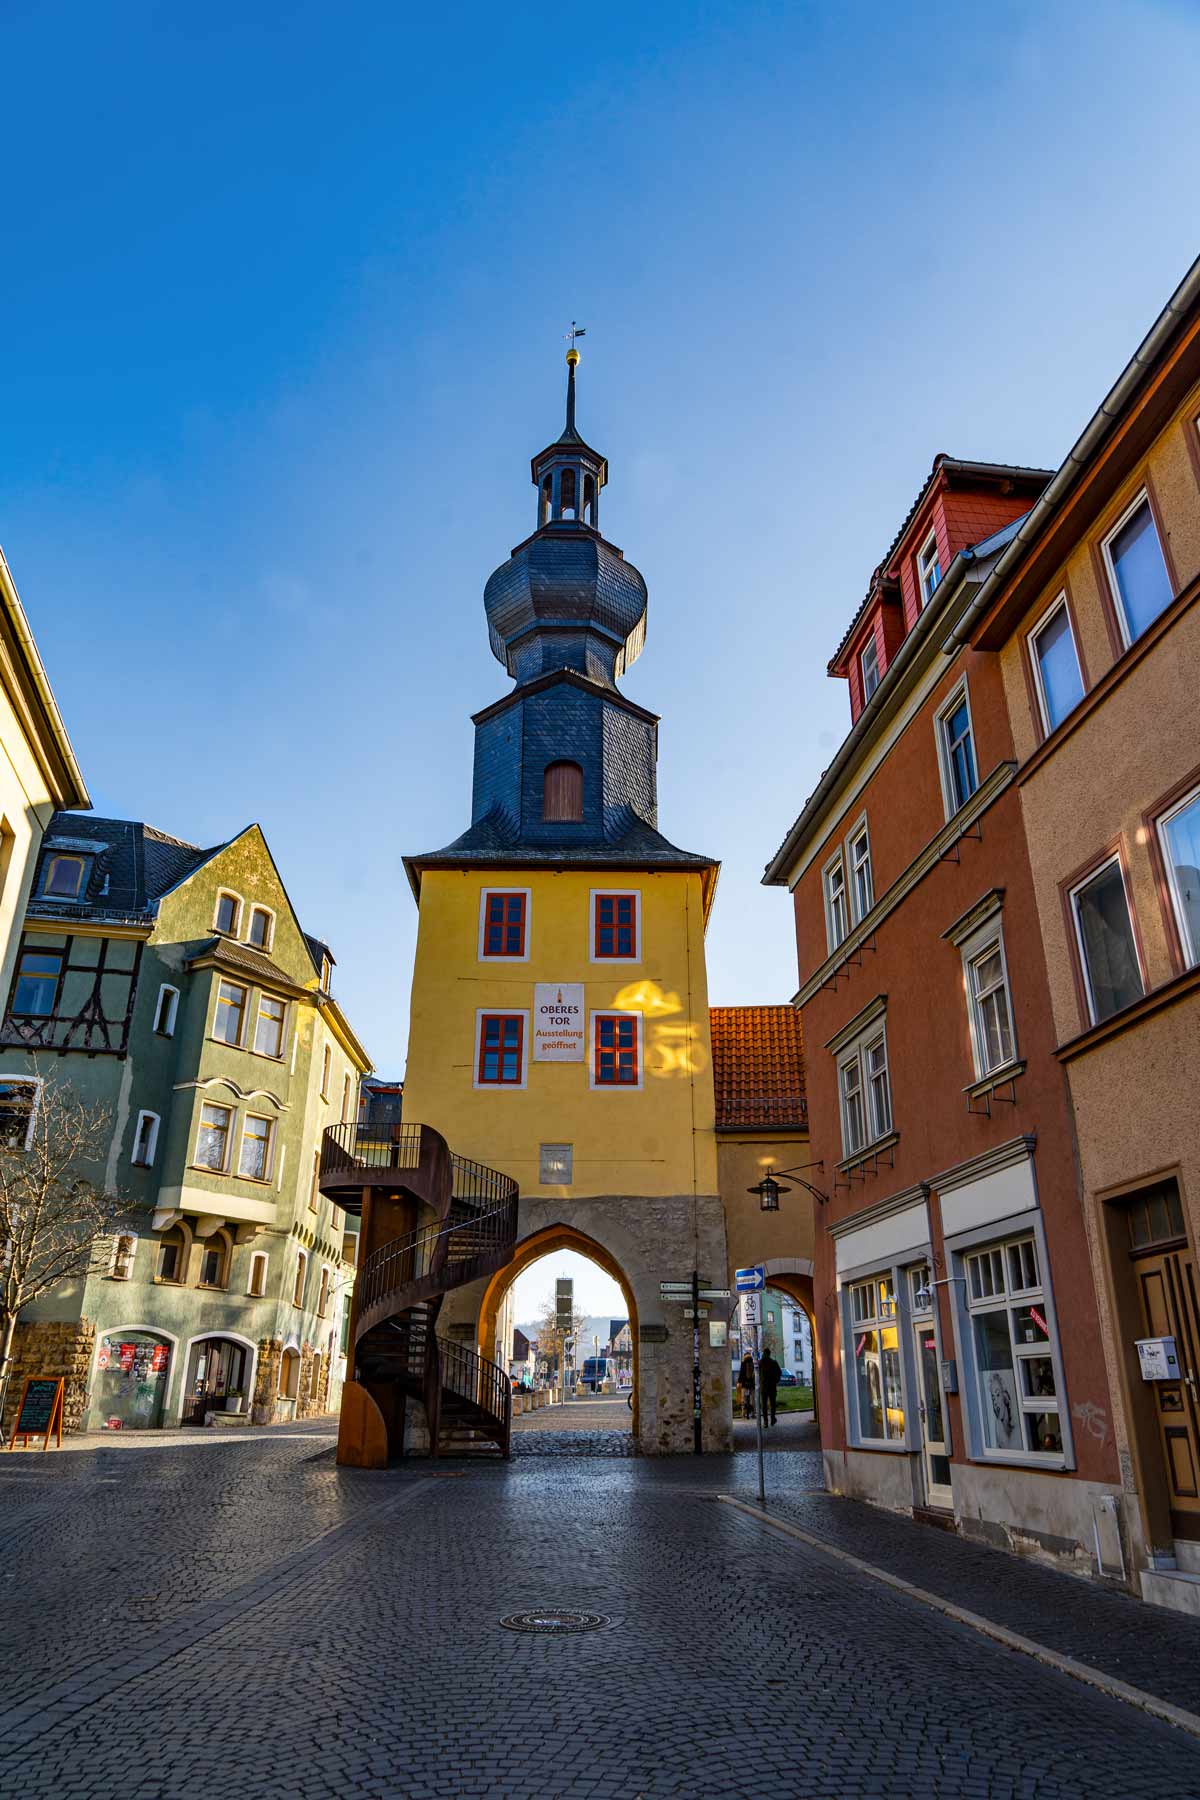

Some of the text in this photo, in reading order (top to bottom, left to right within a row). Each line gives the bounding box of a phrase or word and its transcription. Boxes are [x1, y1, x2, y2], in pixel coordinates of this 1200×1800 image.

[540, 1005, 579, 1014] OBERES
[549, 1017, 570, 1025] TOR
[536, 1029, 583, 1039] Ausstellung
[542, 1041, 576, 1050] geöffnet
